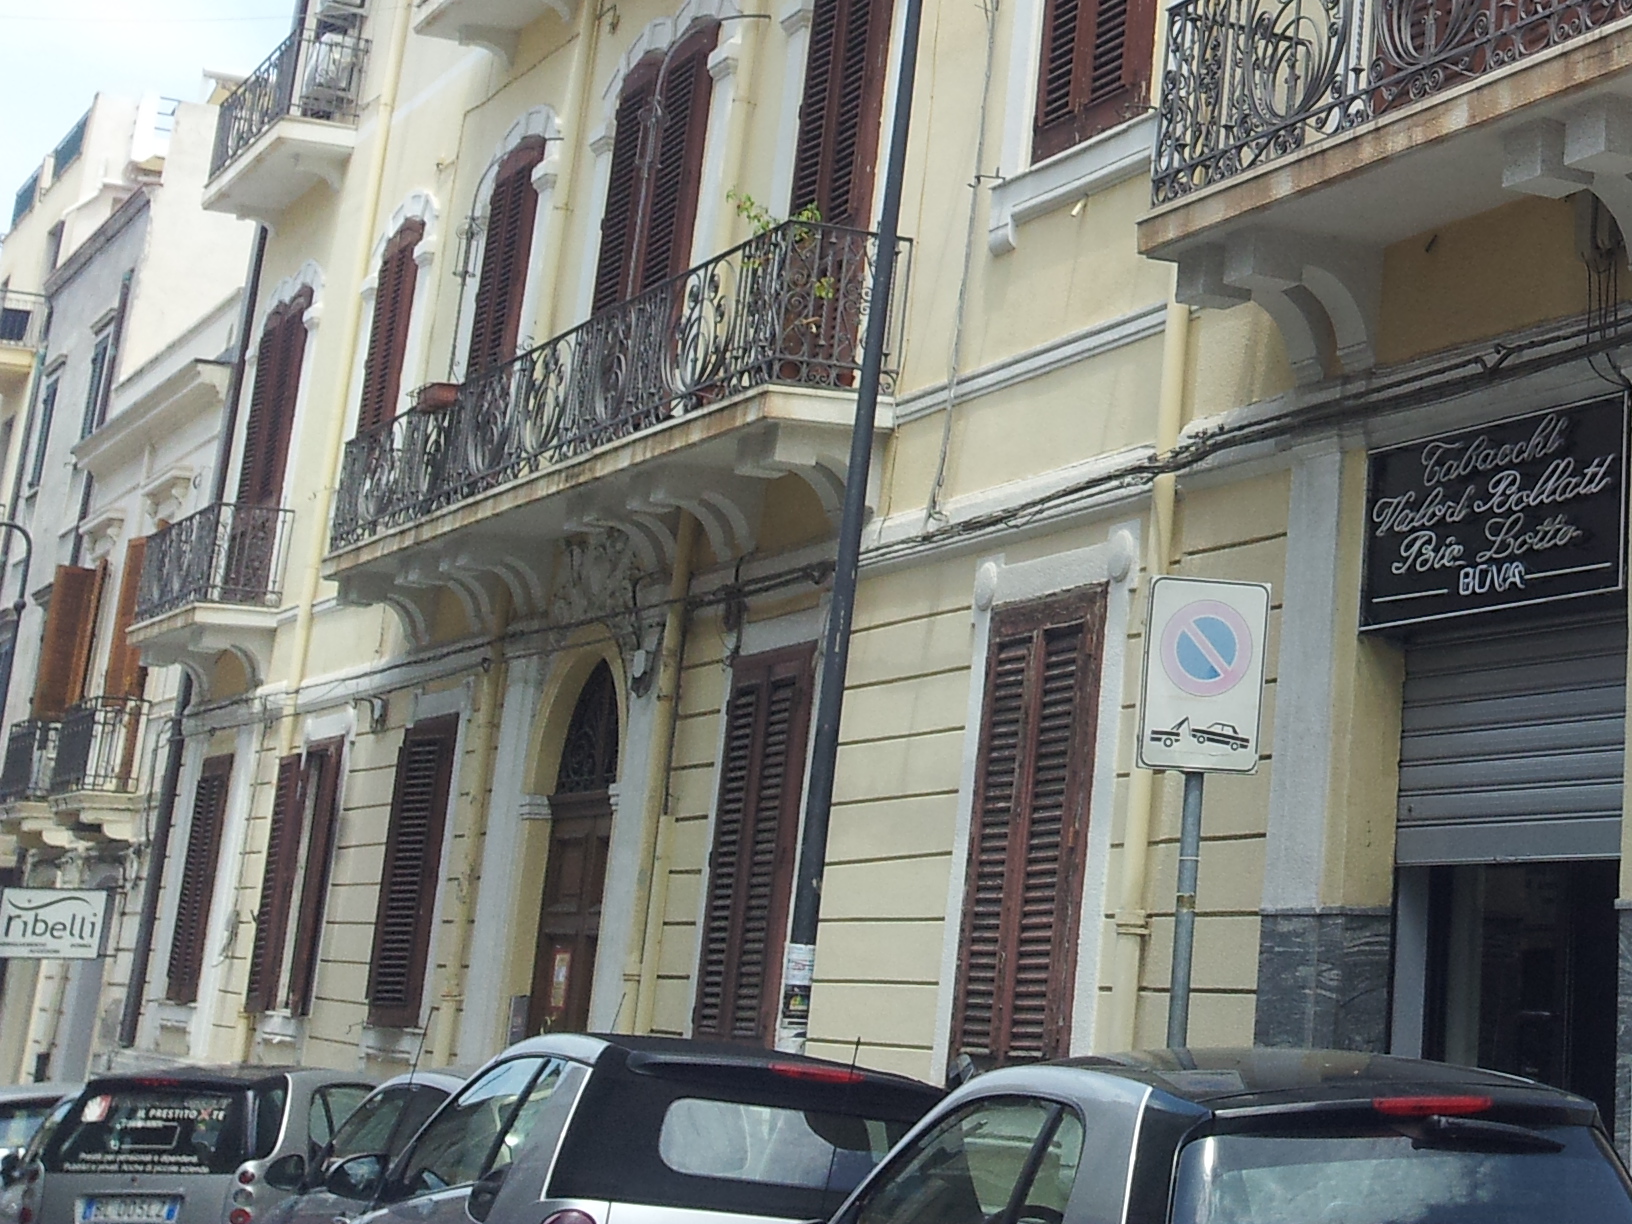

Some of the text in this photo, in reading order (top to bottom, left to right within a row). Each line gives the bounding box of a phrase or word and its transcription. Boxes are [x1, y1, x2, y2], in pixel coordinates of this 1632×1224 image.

[1476, 513, 1583, 563] Lotto
[1458, 561, 1526, 596] BOVA
[148, 1109, 198, 1119] PRESTITO
[212, 1110, 226, 1121] TE
